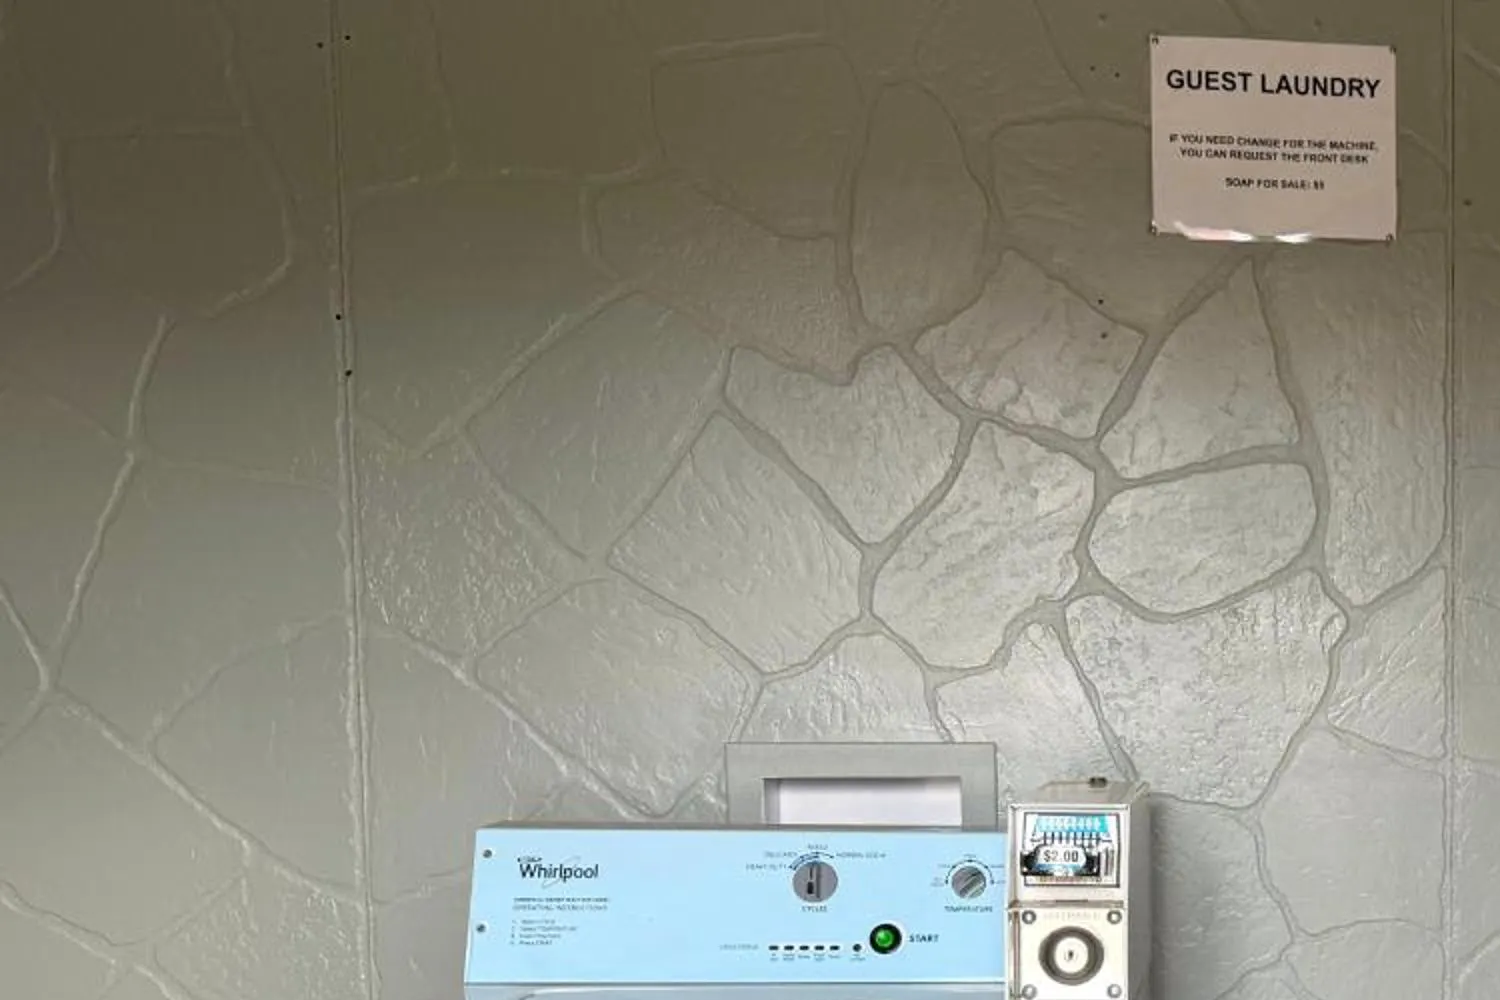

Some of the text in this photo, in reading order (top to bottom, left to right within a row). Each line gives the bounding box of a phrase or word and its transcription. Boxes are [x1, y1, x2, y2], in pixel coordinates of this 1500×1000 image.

[1166, 69, 1381, 99] GUEST LAUNDRY
[1169, 134, 1179, 143] IF
[1181, 134, 1204, 145] YOU
[1206, 136, 1234, 146] NEED
[1237, 137, 1280, 149] CHANGE
[1283, 139, 1304, 149] FOR
[1307, 140, 1326, 150] THE
[1180, 147, 1369, 165] YOU CAN REQUEST THE FRONT DESK
[1225, 177, 1254, 188] SOAP
[1257, 179, 1278, 189] FOR
[1044, 849, 1079, 863] $2.00
[520, 863, 599, 882] Whirlpool
[909, 934, 940, 944] START
